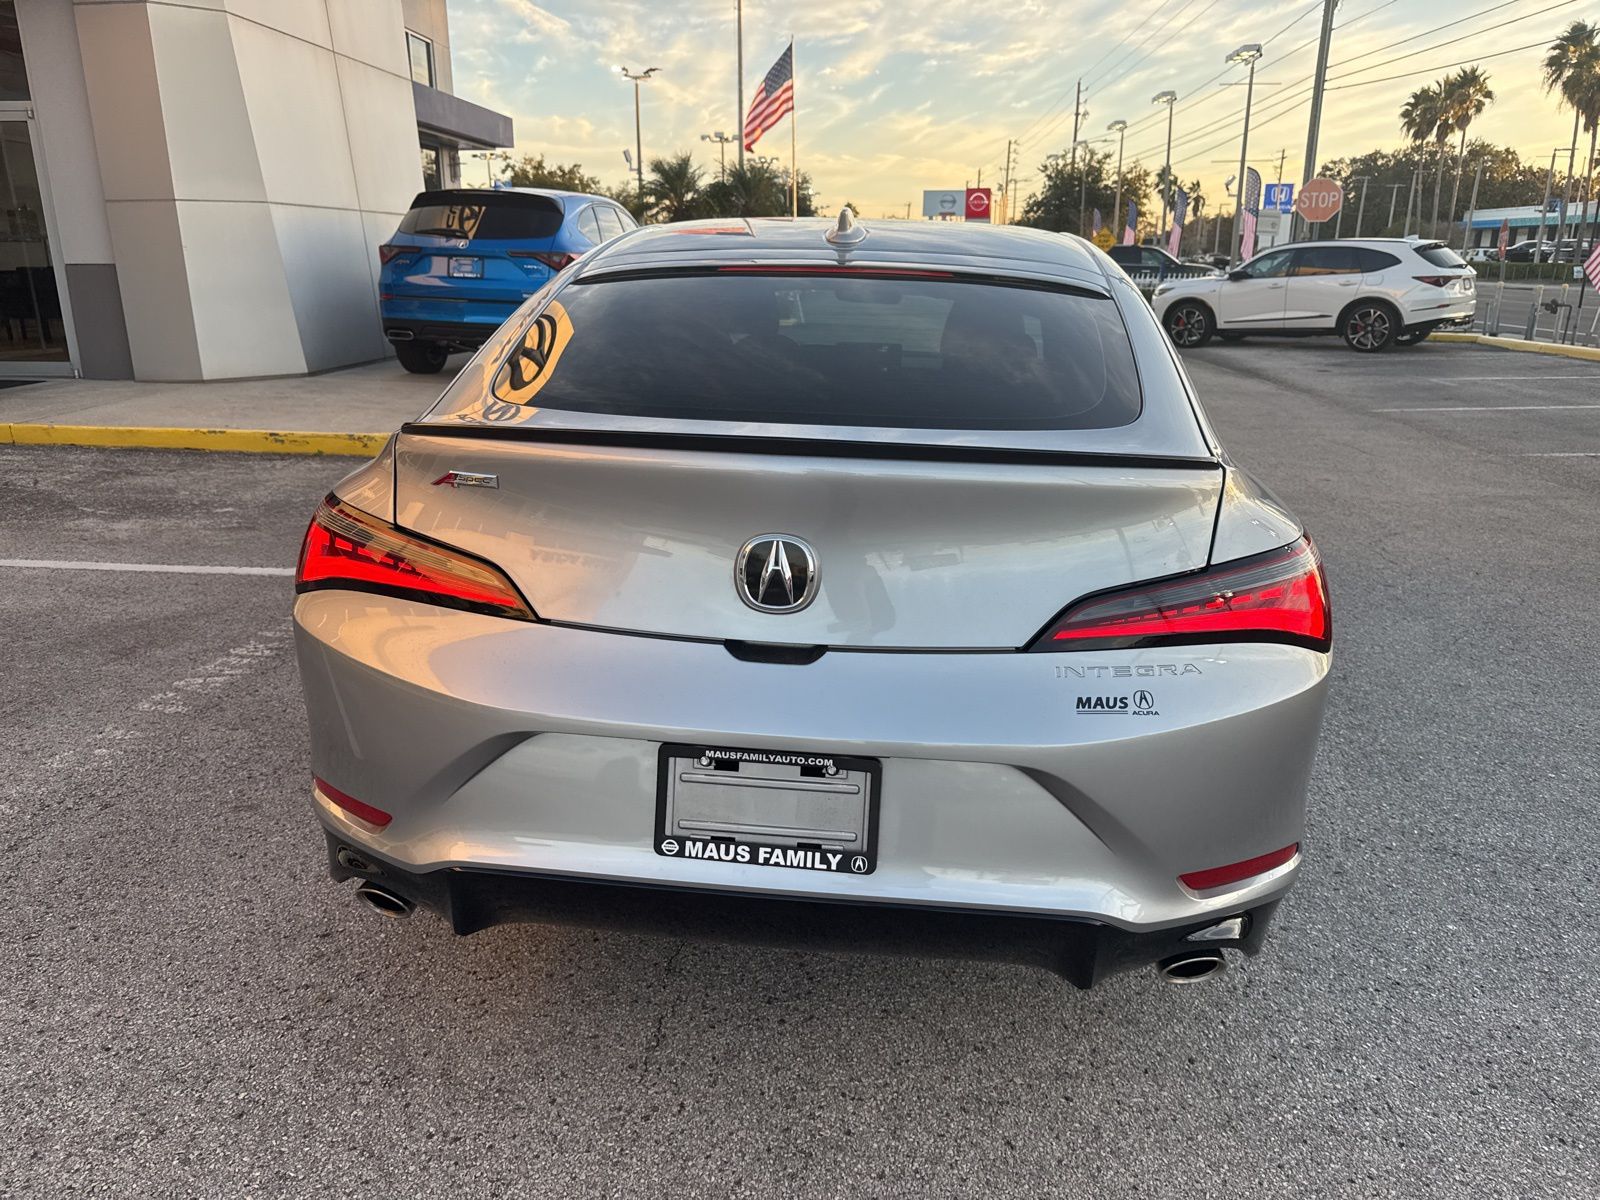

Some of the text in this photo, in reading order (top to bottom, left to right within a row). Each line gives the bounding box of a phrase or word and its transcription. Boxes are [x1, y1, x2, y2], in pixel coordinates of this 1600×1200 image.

[1300, 192, 1339, 208] STOP
[1055, 664, 1202, 678] INTEGRA
[1076, 697, 1128, 709] MAUS
[705, 750, 833, 766] MAUSFAMILYAUTO.COM
[685, 841, 842, 871] MAUS FAMILY
